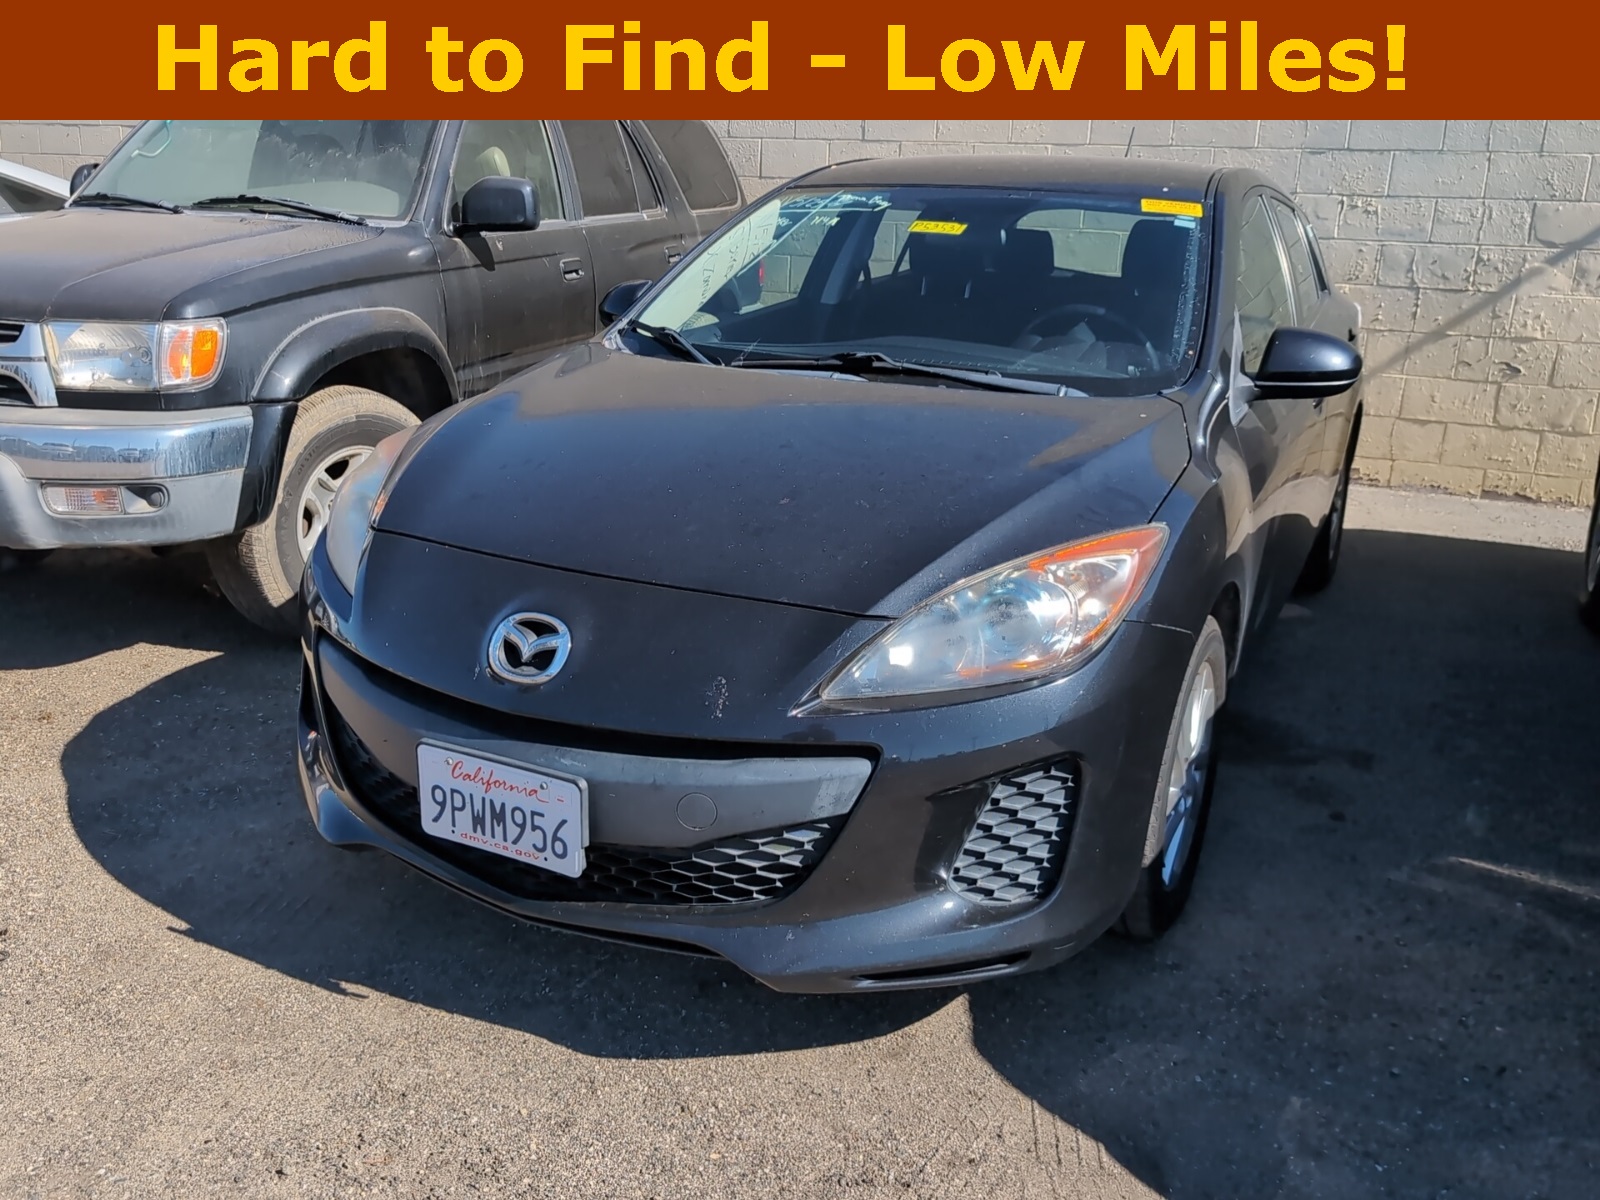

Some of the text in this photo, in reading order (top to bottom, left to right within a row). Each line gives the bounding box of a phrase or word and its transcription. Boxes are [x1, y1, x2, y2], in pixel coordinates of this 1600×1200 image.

[450, 760, 550, 804] California
[430, 783, 569, 861] 9PWM956
[459, 831, 541, 861] dmv.ca.gov
